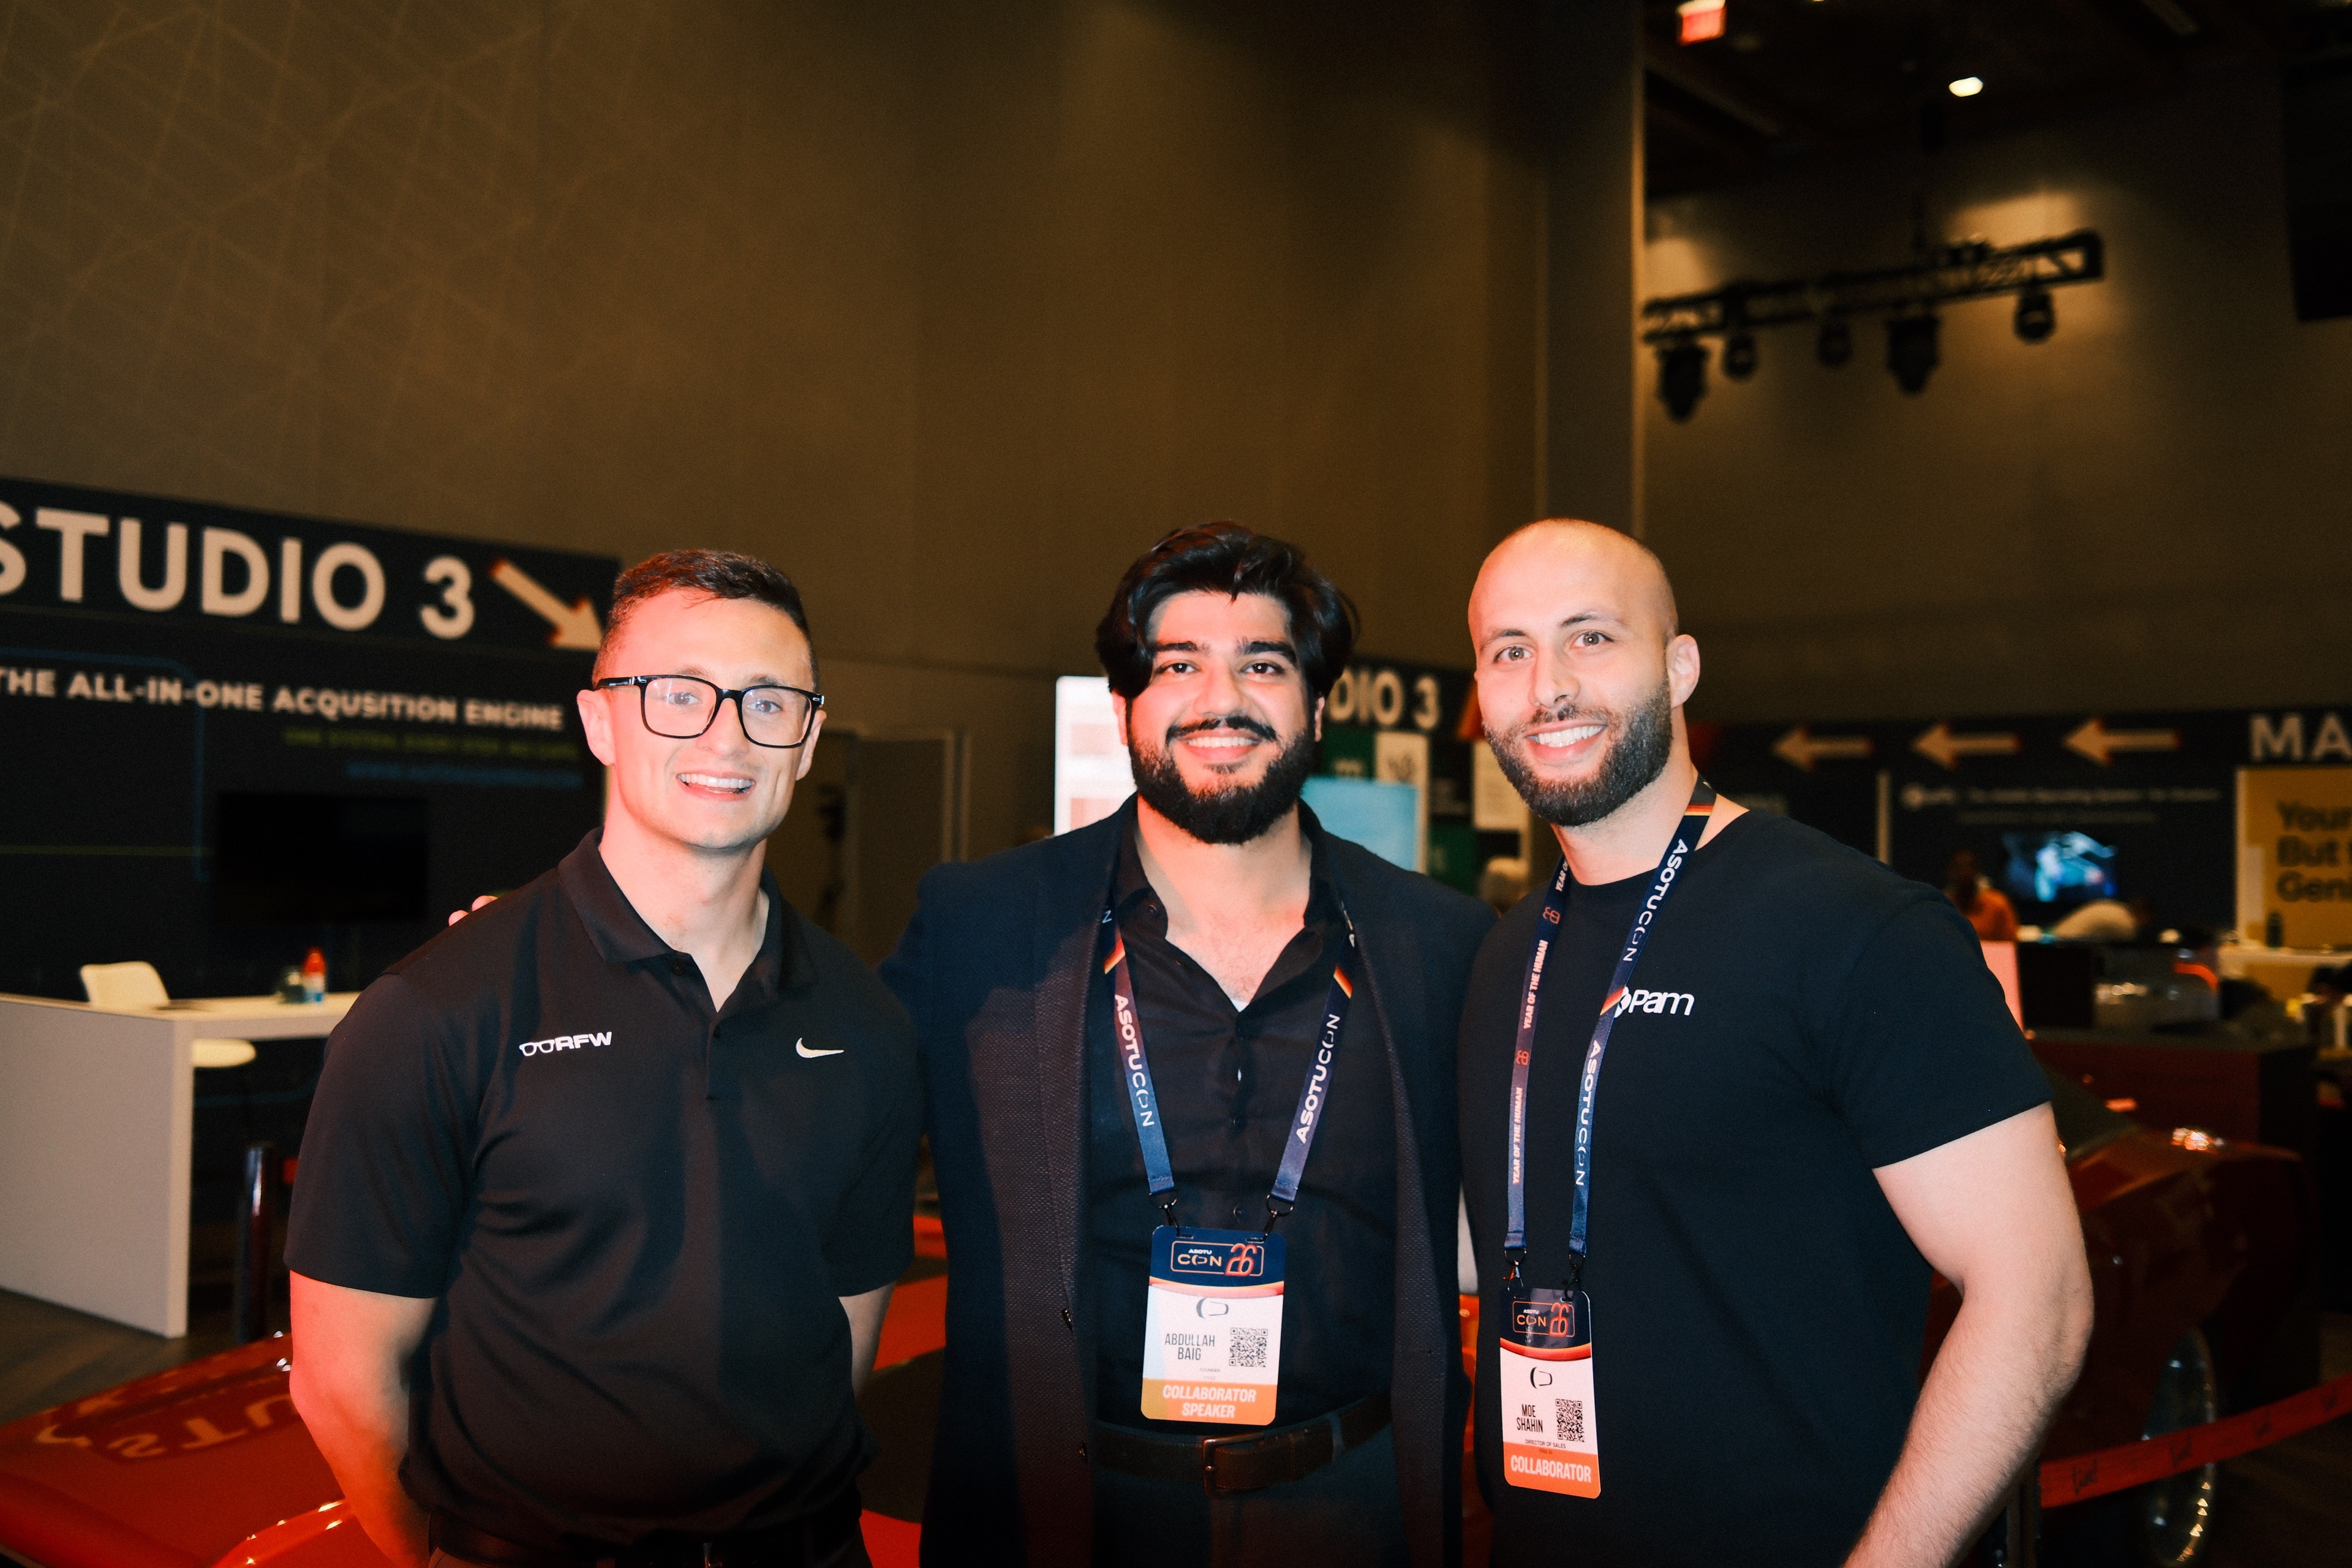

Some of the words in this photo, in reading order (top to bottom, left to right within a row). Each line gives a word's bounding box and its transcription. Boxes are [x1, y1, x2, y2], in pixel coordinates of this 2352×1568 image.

[420, 554, 475, 639] 3
[0, 666, 56, 698] HE
[67, 671, 263, 712] ALL-IN-ONE
[464, 698, 565, 732] ENGINE
[1413, 676, 1439, 729] 3
[1532, 939, 1548, 973] HUMAN
[1529, 973, 1540, 990] THE
[1527, 991, 1536, 1005] OF
[1523, 1005, 1534, 1029] YEAR
[1514, 1087, 1523, 1123] HUMAN
[1513, 1144, 1520, 1158] OF
[1225, 1243, 1257, 1276] 26
[1549, 1302, 1570, 1337] 26
[1164, 1333, 1216, 1348] ABDULLAH
[1177, 1347, 1202, 1361] BAIG
[1163, 1384, 1257, 1403] COLLABORATOR
[1182, 1403, 1236, 1419] SPEAKER
[1521, 1404, 1536, 1419] MOE
[1517, 1417, 1544, 1434] SHAHIN
[1510, 1453, 1591, 1483] COLLABORATOR
